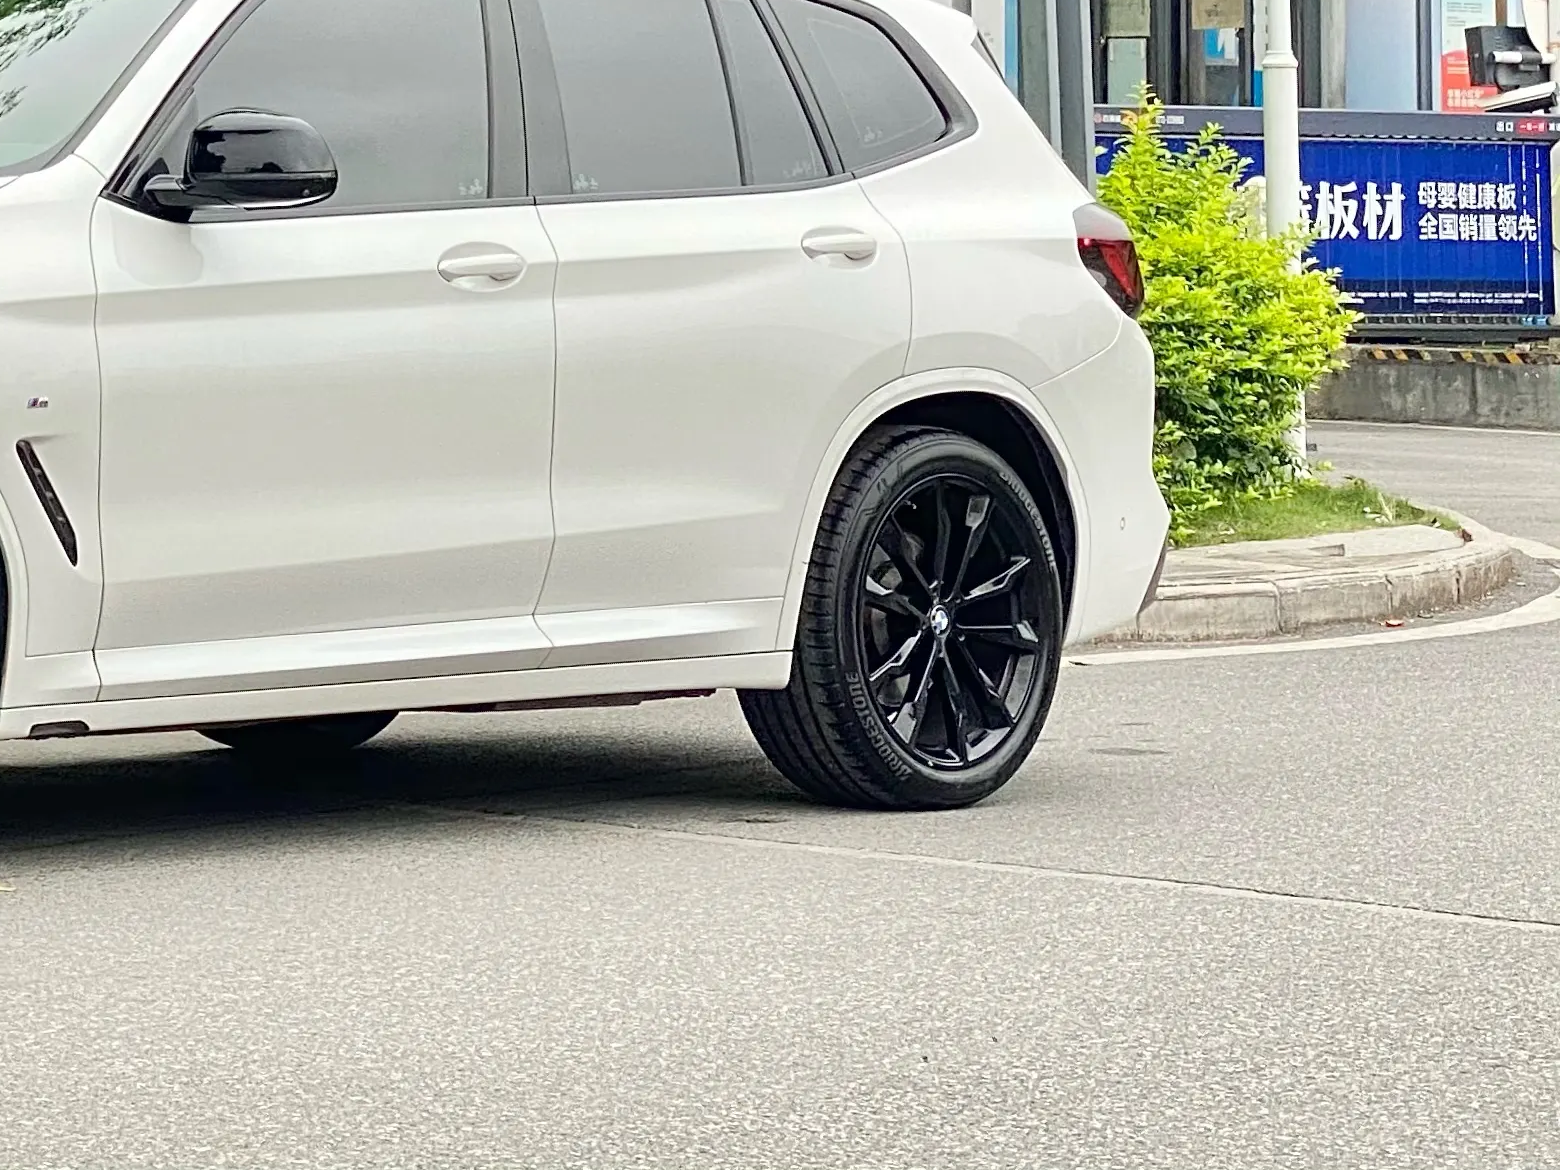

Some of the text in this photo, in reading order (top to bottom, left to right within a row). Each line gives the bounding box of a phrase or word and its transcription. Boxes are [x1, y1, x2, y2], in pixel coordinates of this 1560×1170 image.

[1417, 182, 1517, 211] 母婴健康板
[1418, 213, 1537, 242] 全国销量领先
[845, 672, 913, 781] BRIDGESTONE
